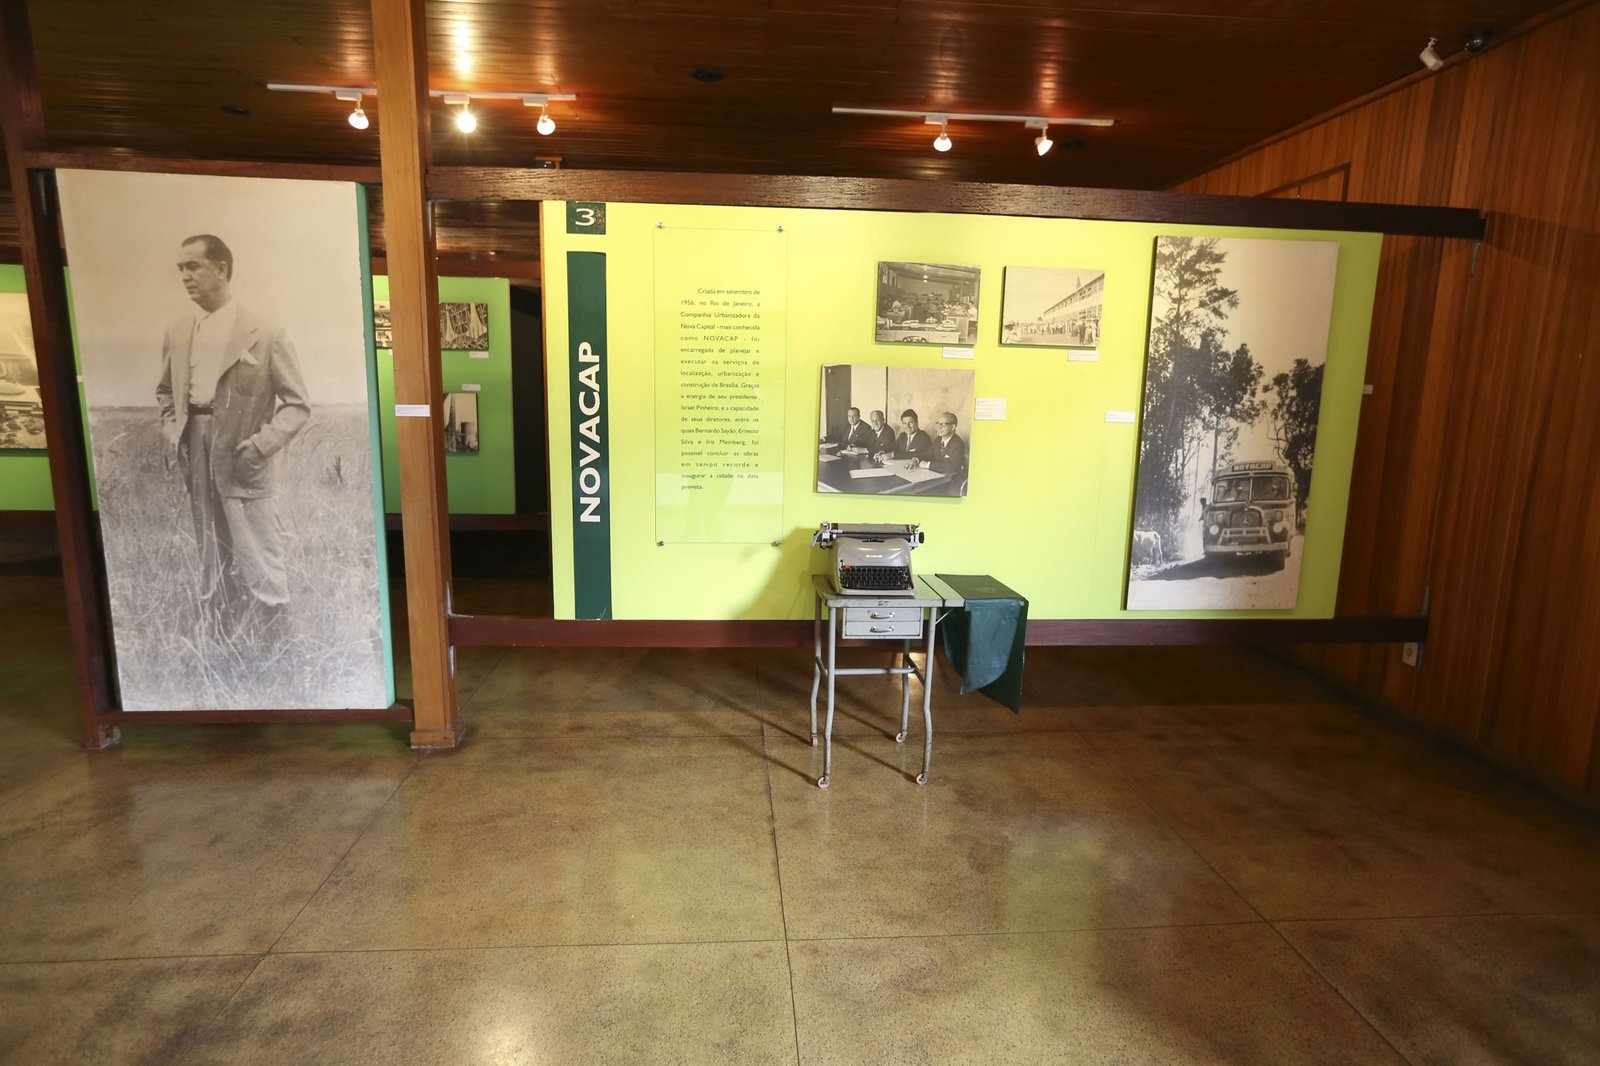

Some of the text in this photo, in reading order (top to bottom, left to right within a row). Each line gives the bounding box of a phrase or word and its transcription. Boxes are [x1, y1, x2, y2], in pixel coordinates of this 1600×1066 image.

[575, 208, 595, 226] 3
[680, 311, 711, 319] Companhia
[578, 341, 601, 523] NOVACAP
